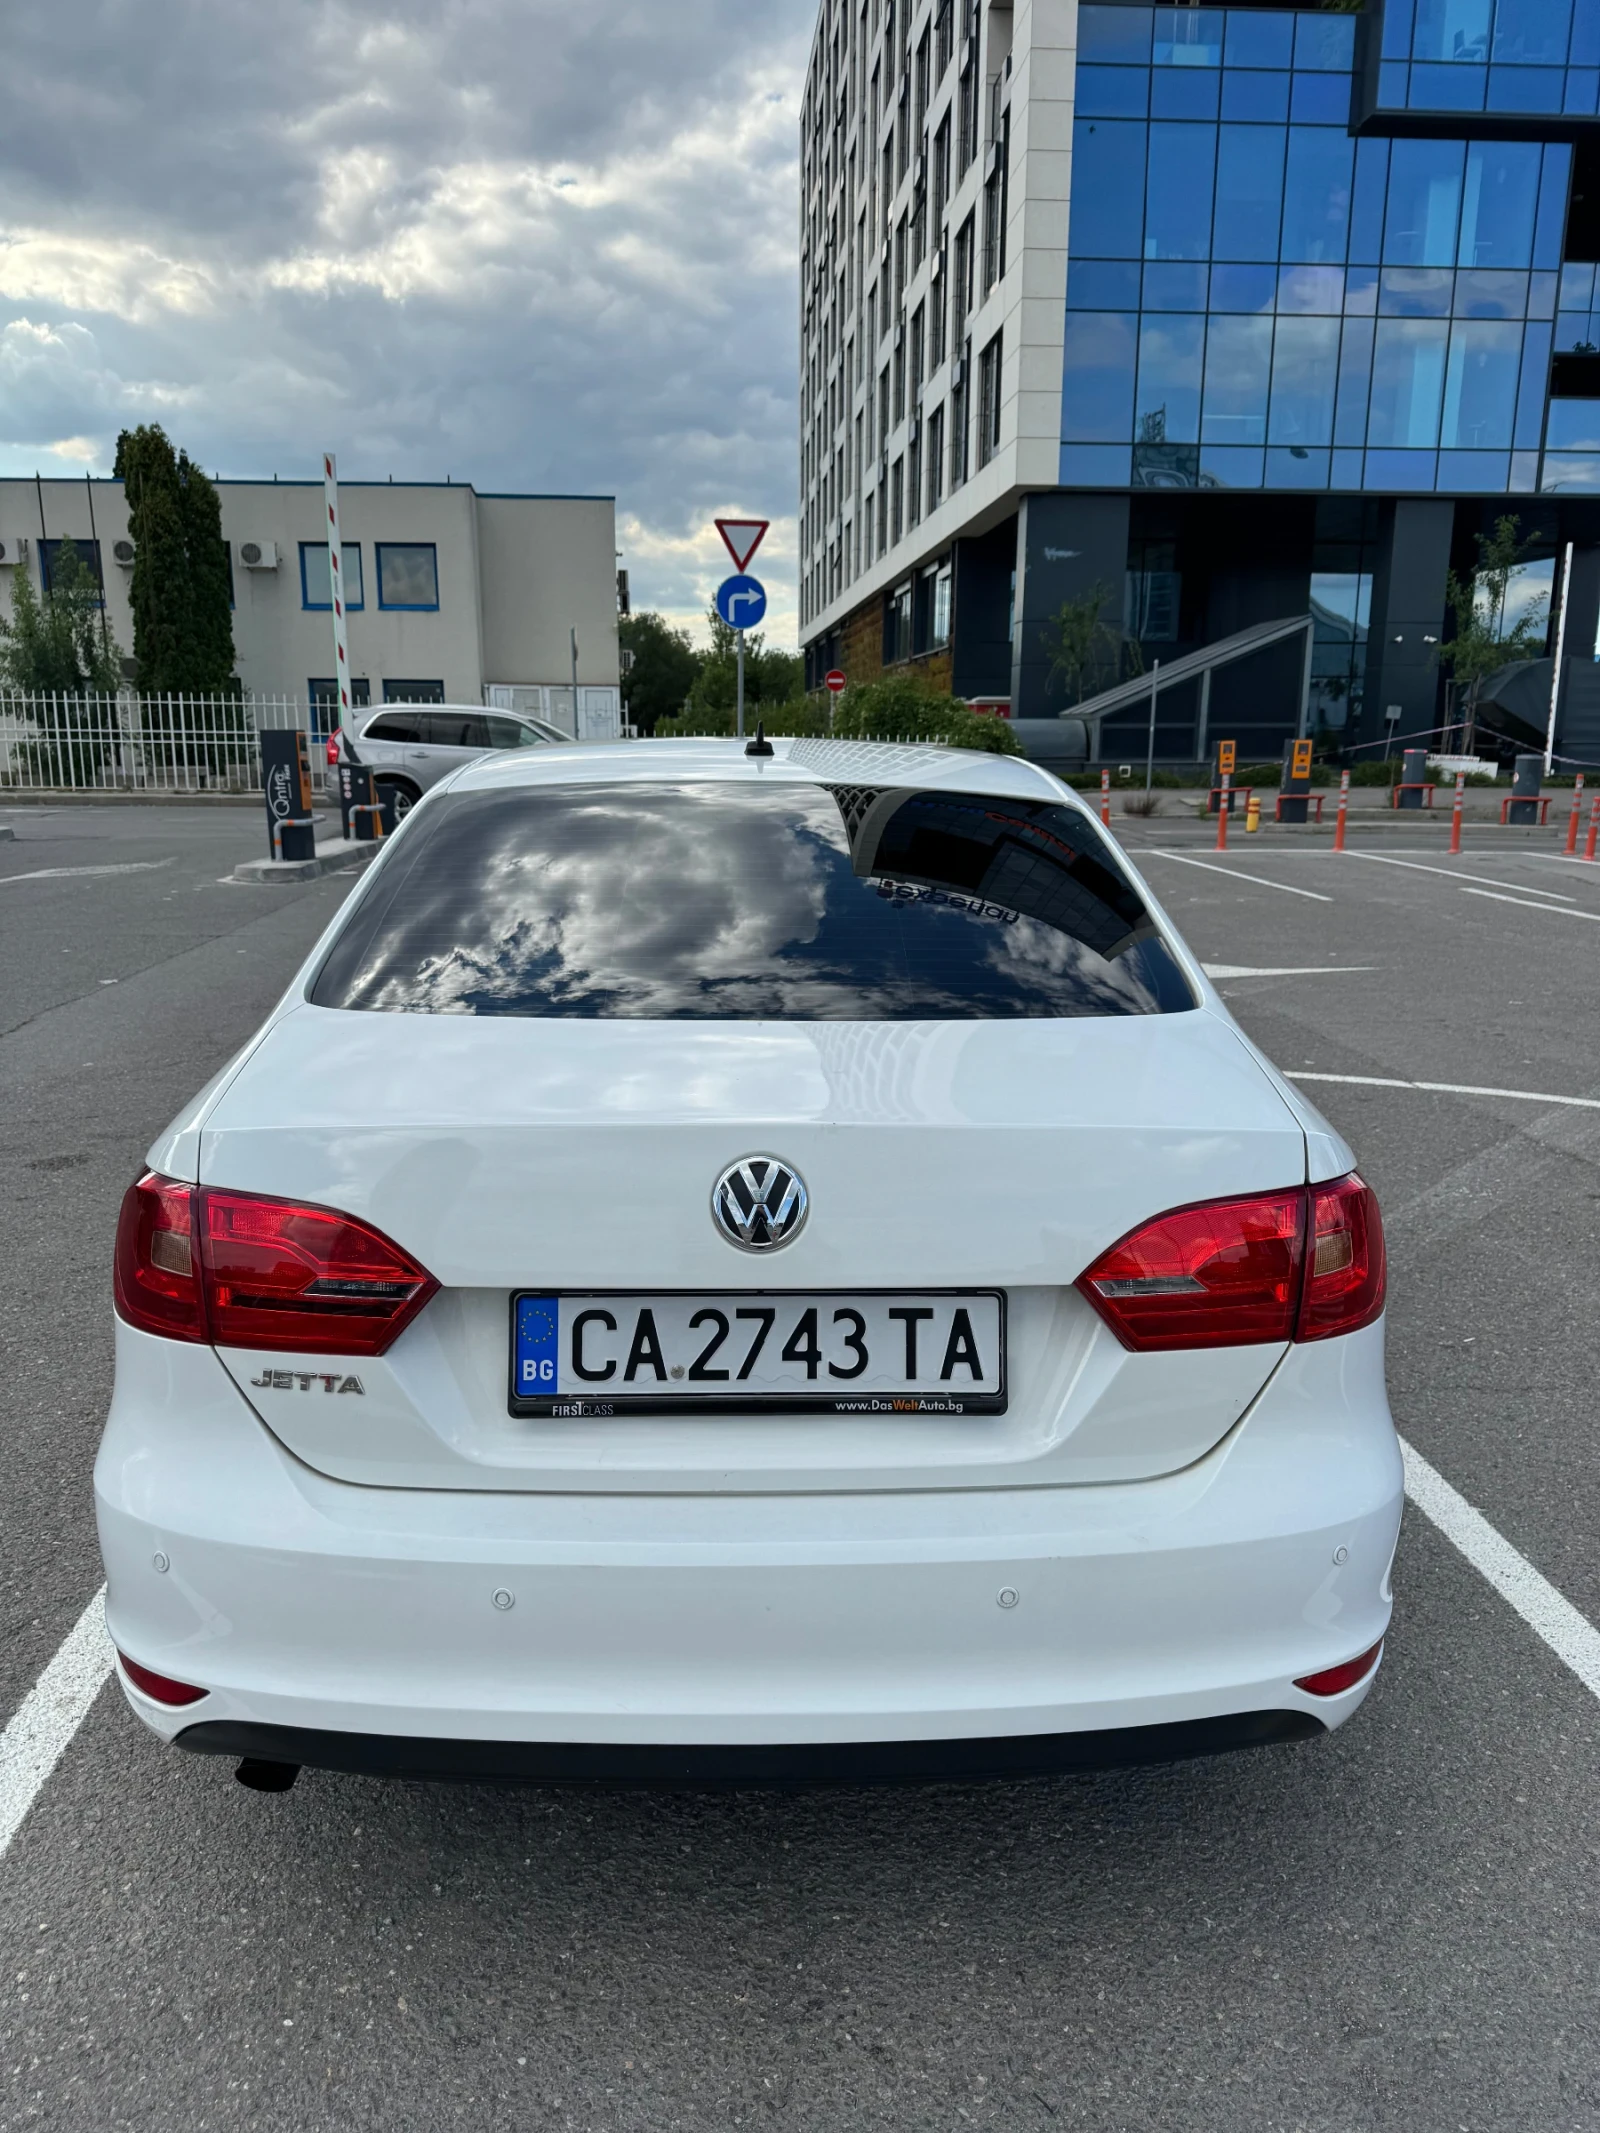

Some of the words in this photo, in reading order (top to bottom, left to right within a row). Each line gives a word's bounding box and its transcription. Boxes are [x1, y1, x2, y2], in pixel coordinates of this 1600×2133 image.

[572, 1308, 668, 1381] CA
[688, 1308, 869, 1381] 2743
[888, 1307, 984, 1381] TA
[250, 1368, 366, 1395] JETTA
[522, 1359, 554, 1381] BG
[835, 1399, 964, 1413] www.DasWeltAuto.bg
